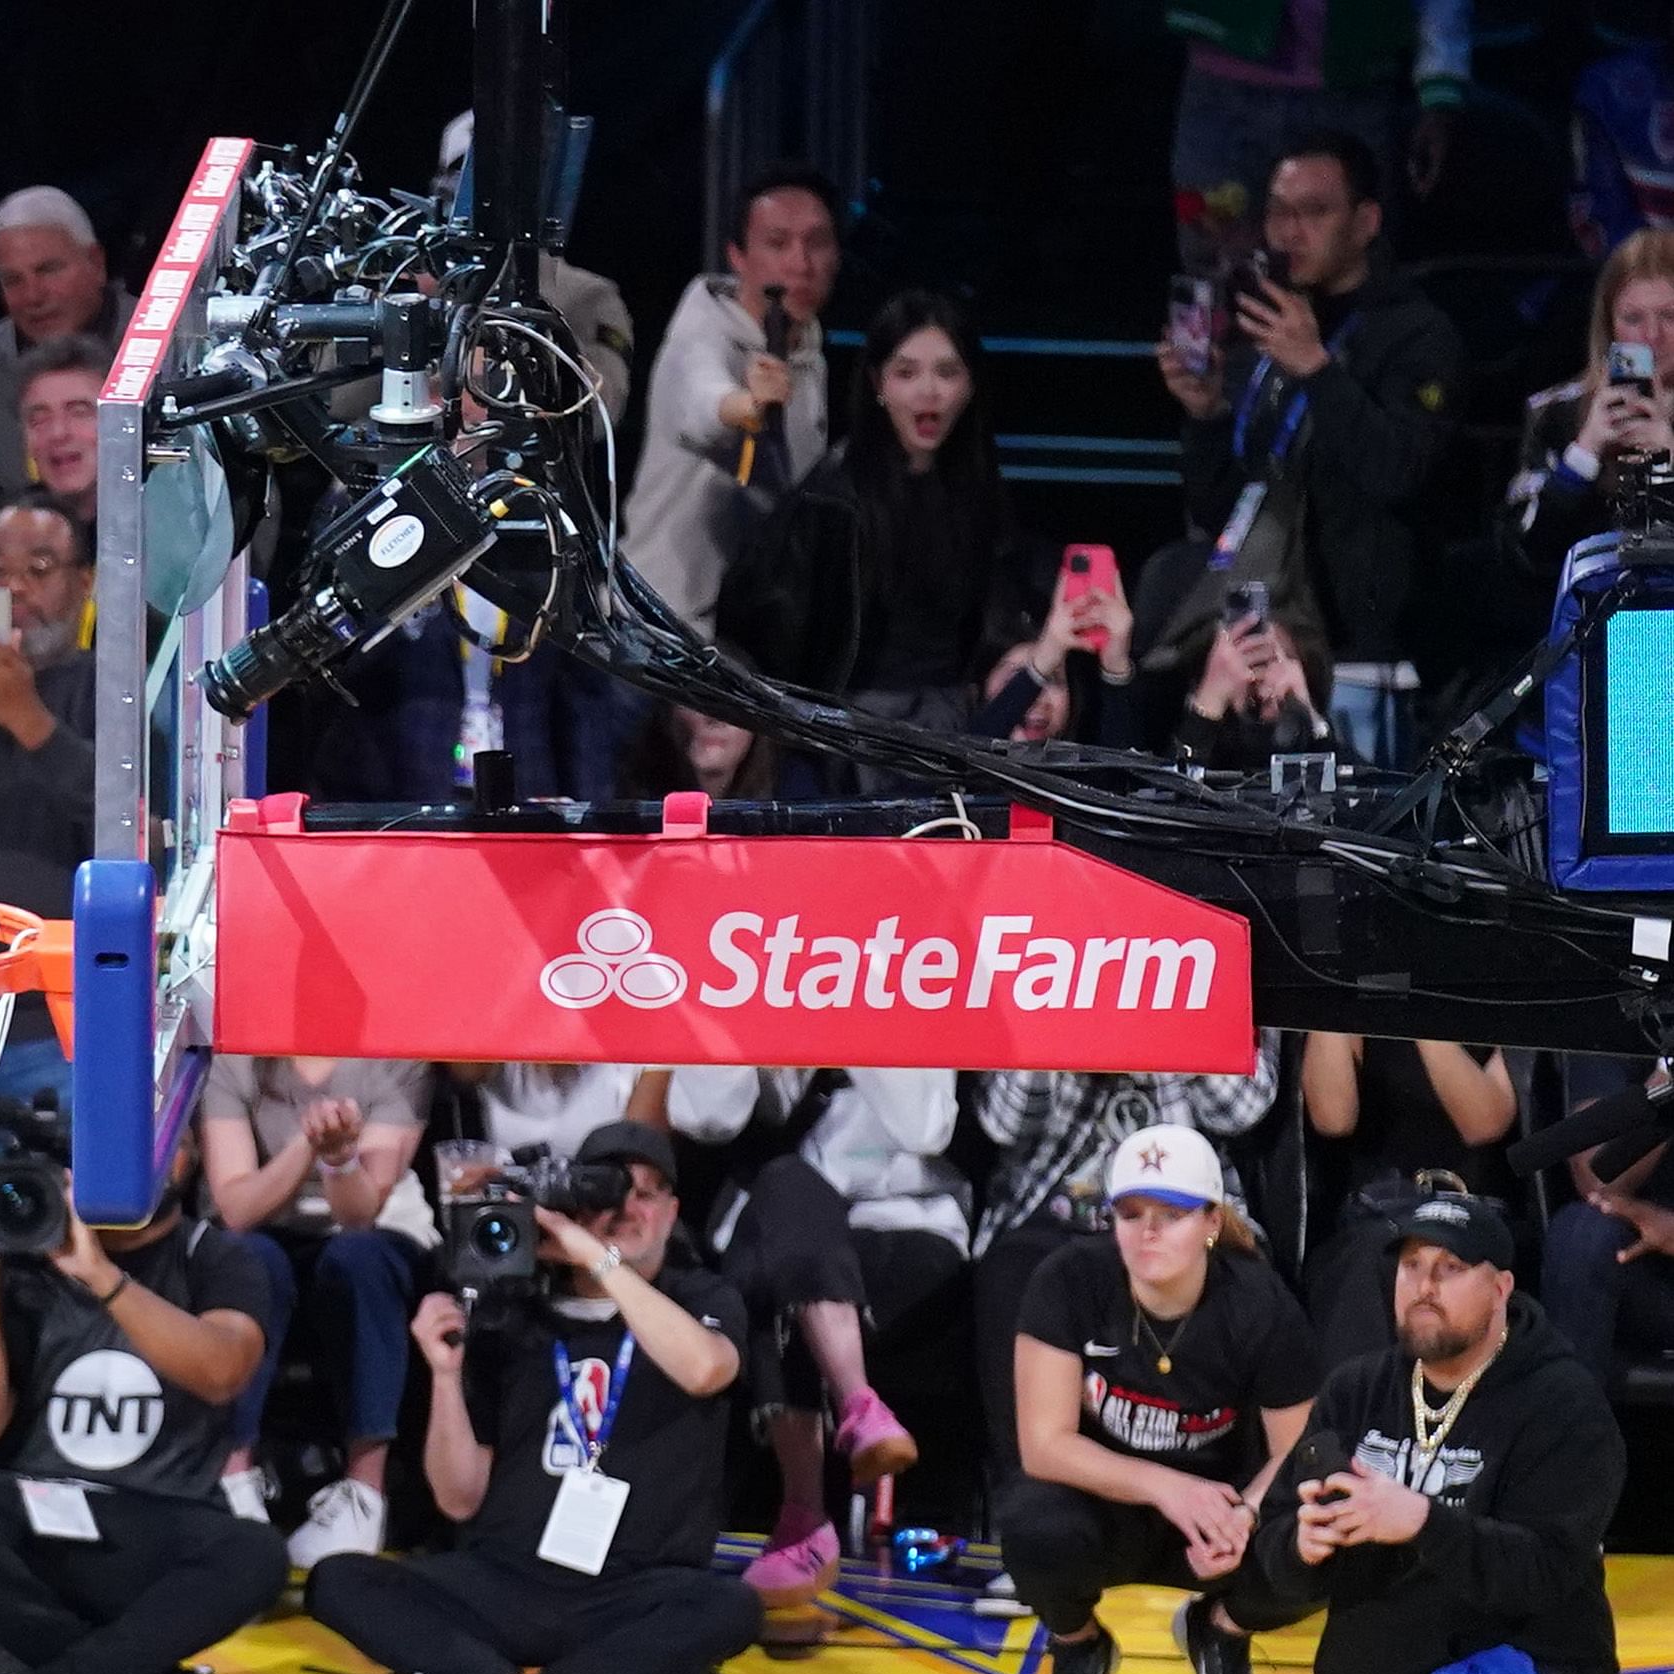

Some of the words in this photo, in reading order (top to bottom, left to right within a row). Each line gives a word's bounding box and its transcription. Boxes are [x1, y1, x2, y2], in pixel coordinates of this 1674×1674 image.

[699, 911, 959, 1010] State
[966, 915, 1217, 1010] Farm
[49, 1390, 165, 1437] TNT
[1135, 1403, 1180, 1432] STAR
